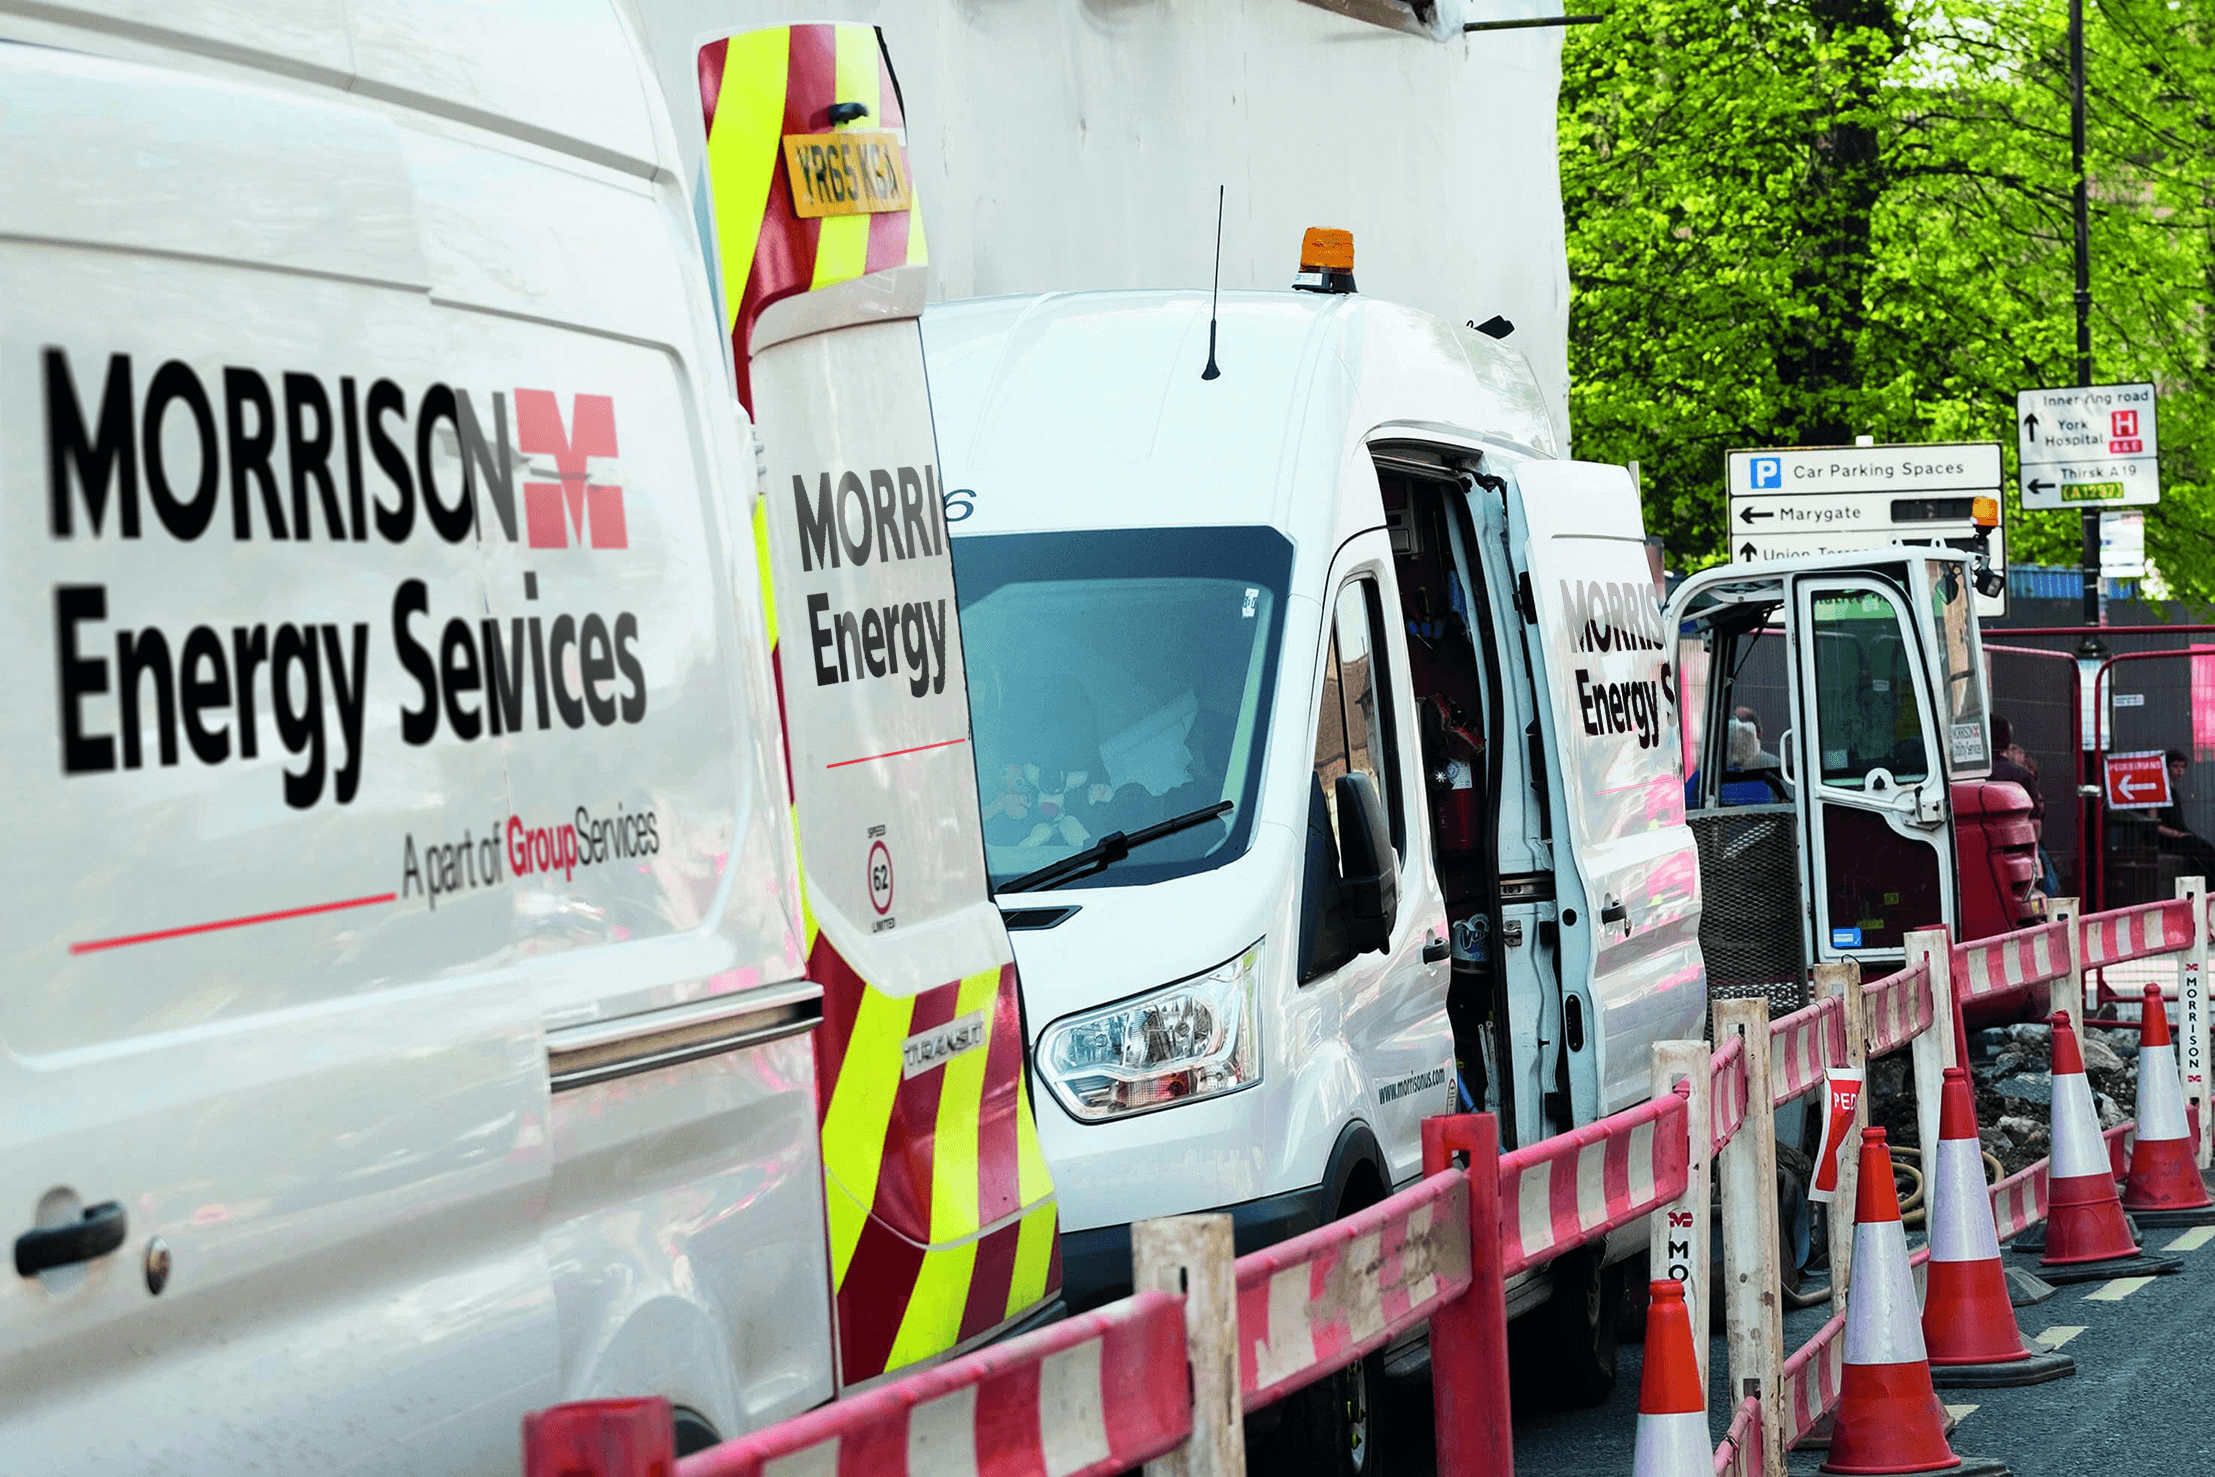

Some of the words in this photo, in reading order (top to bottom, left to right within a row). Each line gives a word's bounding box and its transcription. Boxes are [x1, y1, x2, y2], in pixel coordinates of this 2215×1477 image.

[2043, 394, 2079, 407] Inner
[2083, 392, 2112, 405] ring
[2117, 390, 2149, 402] road
[2044, 433, 2104, 447] Hospital
[2057, 418, 2088, 431] York
[2114, 411, 2135, 436] H
[40, 343, 519, 544] MORRISON
[1755, 458, 1779, 488] P
[1793, 464, 1823, 480] Car
[1830, 462, 1894, 479] Parking
[1902, 461, 1964, 477] Spaces
[2060, 466, 2104, 480] Thirsk
[792, 464, 946, 573] MORRI
[1780, 506, 1861, 523] Marygate
[1559, 579, 1665, 654] MORRIS
[806, 592, 946, 698] Energy
[53, 580, 369, 811] Energy
[1575, 668, 1660, 750] Energy
[867, 824, 886, 839] SPEED
[402, 833, 424, 898] A
[425, 828, 477, 912] part
[478, 819, 503, 887] of
[873, 864, 889, 892] 62
[872, 916, 896, 934] LIMITED
[2186, 976, 2199, 1069] MORRISON
[903, 1020, 984, 1067] TRANSIT
